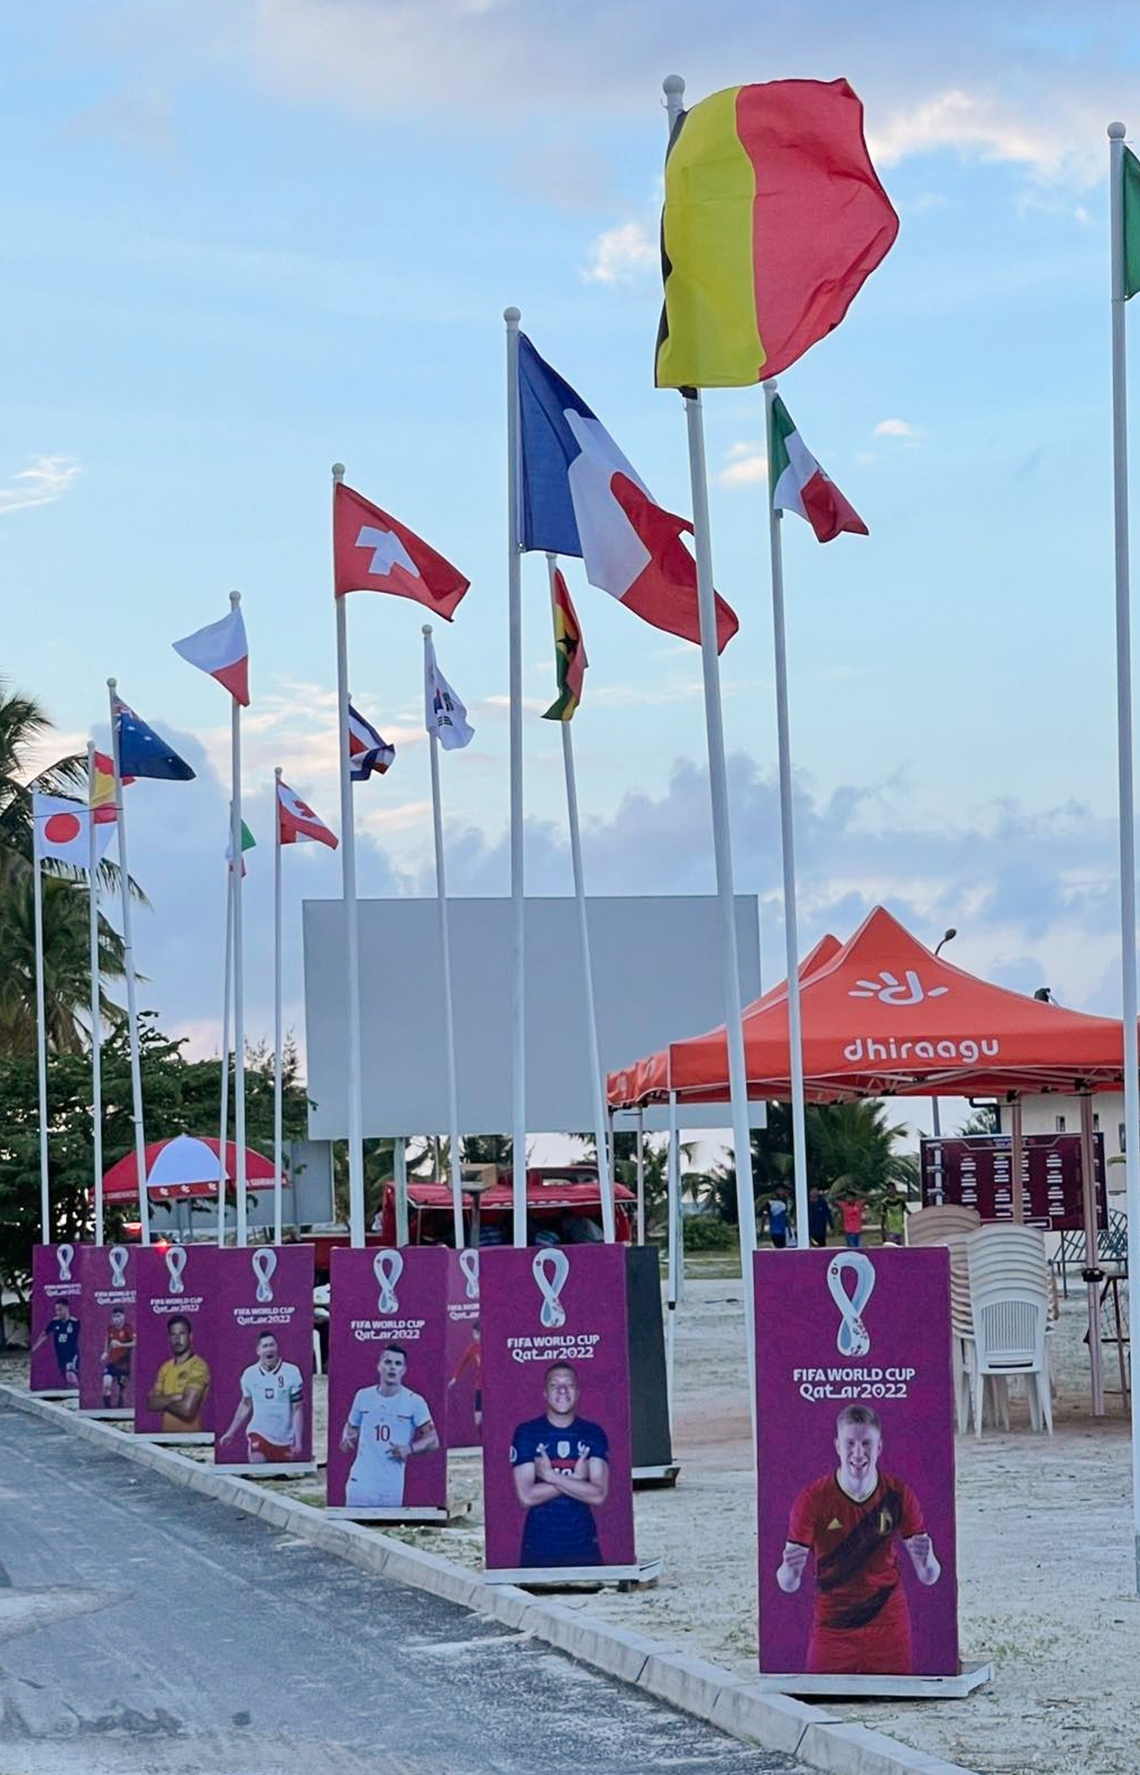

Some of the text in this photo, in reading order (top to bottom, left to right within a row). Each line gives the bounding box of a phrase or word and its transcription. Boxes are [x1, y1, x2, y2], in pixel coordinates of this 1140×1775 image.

[843, 1037, 1000, 1063] dhiraagu
[350, 1319, 426, 1330] FIFA WORLD CUP
[506, 1334, 600, 1349] FIFA WORLD CUP
[793, 1367, 916, 1382] FIFA WORLD CUP
[374, 1423, 391, 1442] 10
